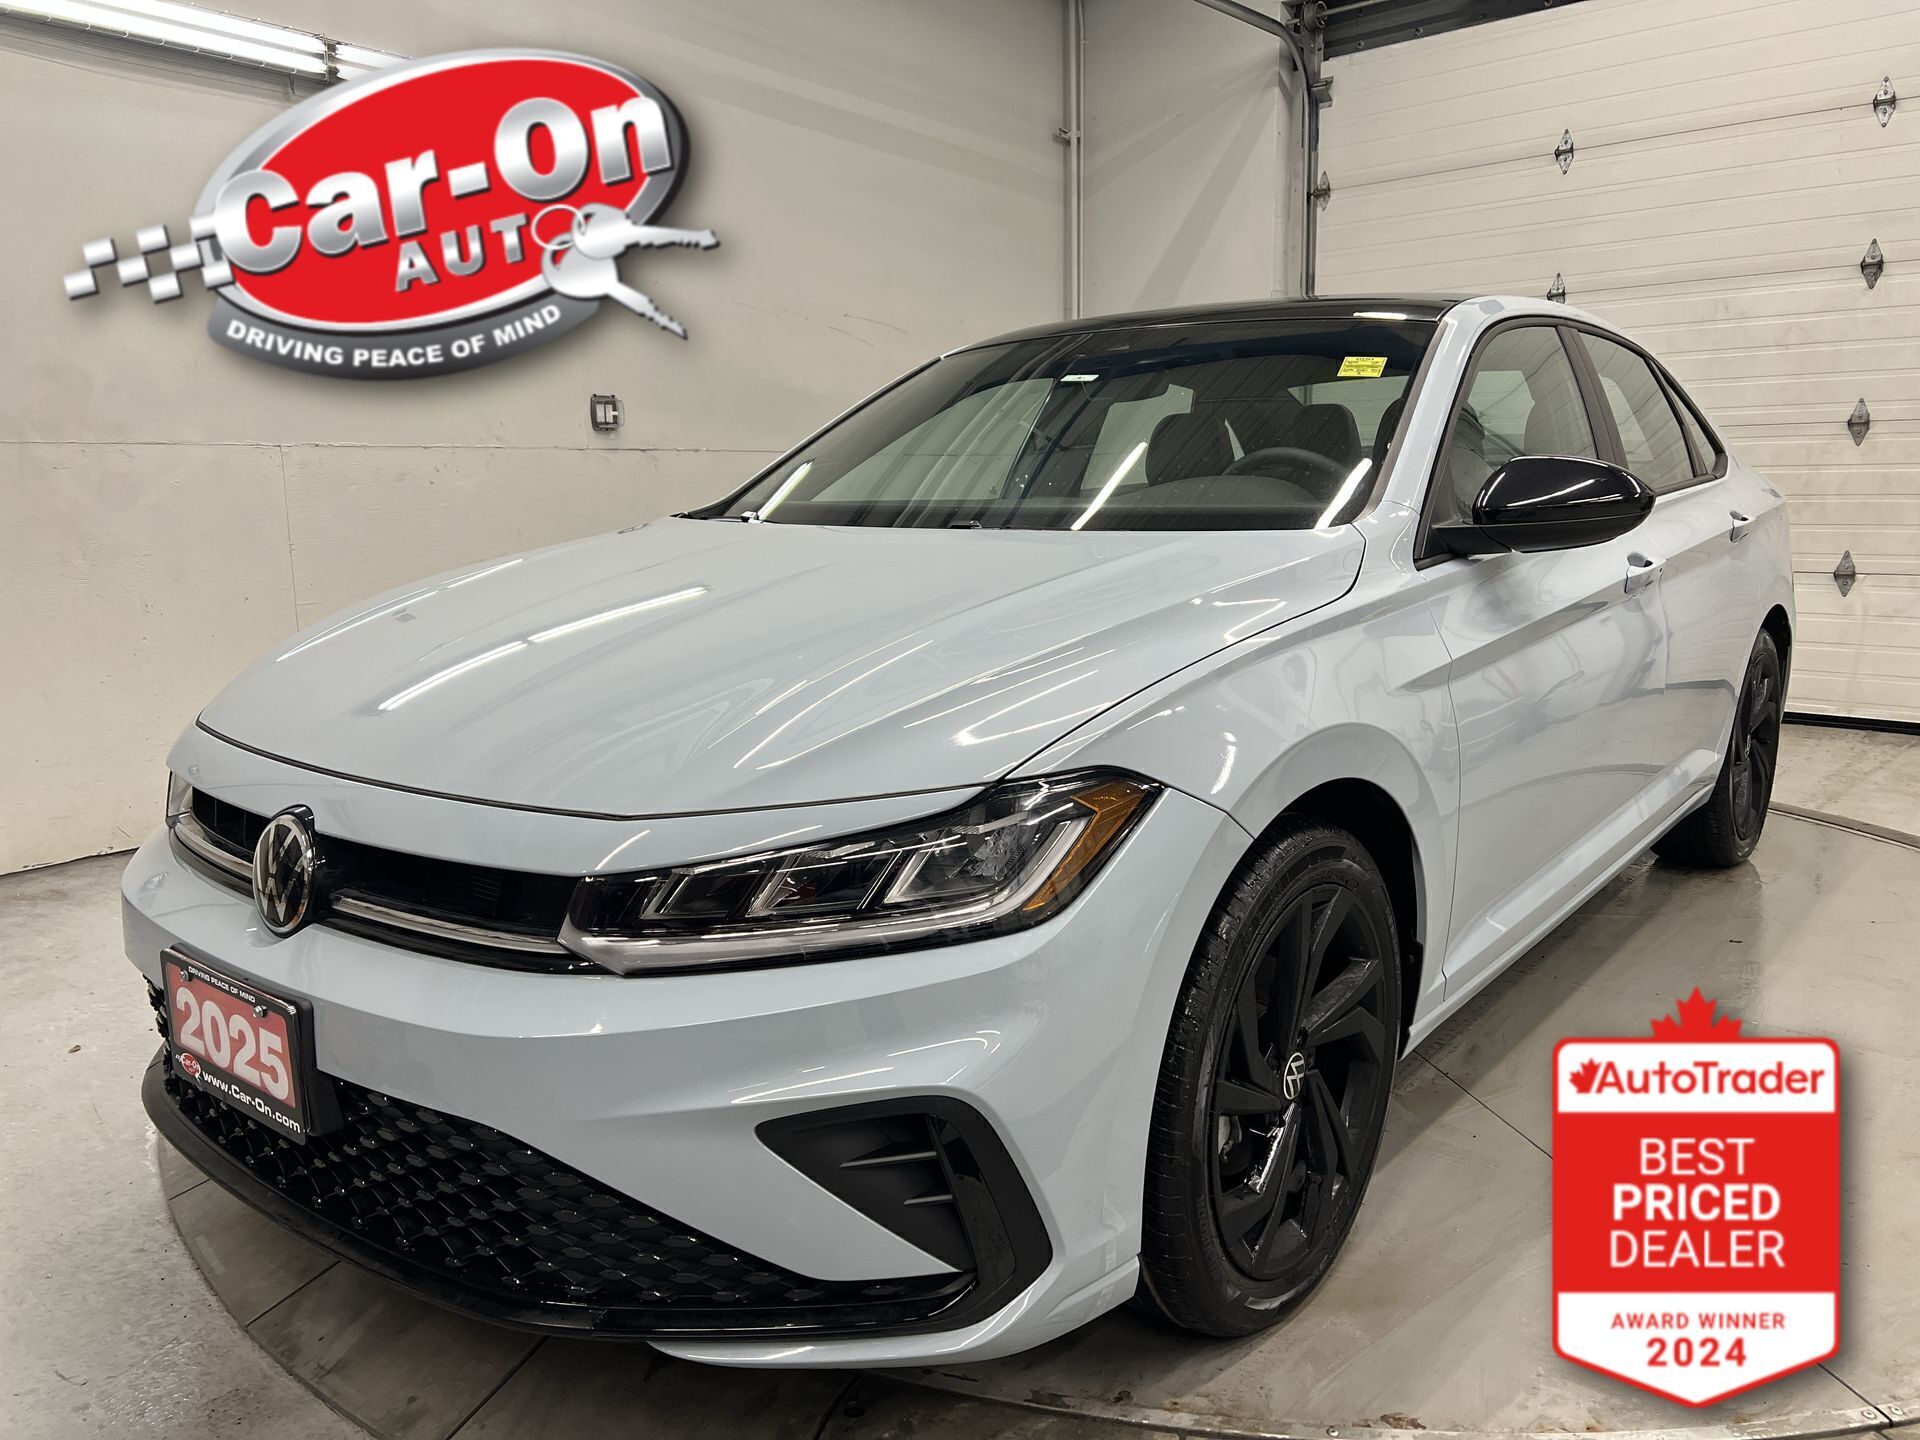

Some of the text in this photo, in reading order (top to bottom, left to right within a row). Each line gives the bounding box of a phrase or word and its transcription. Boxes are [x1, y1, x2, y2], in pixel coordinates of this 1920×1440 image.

[188, 966, 256, 1003] DRIVING PEACE OF MIND
[176, 986, 289, 1100] 2025
[202, 1070, 301, 1134] www.Car-On.com
